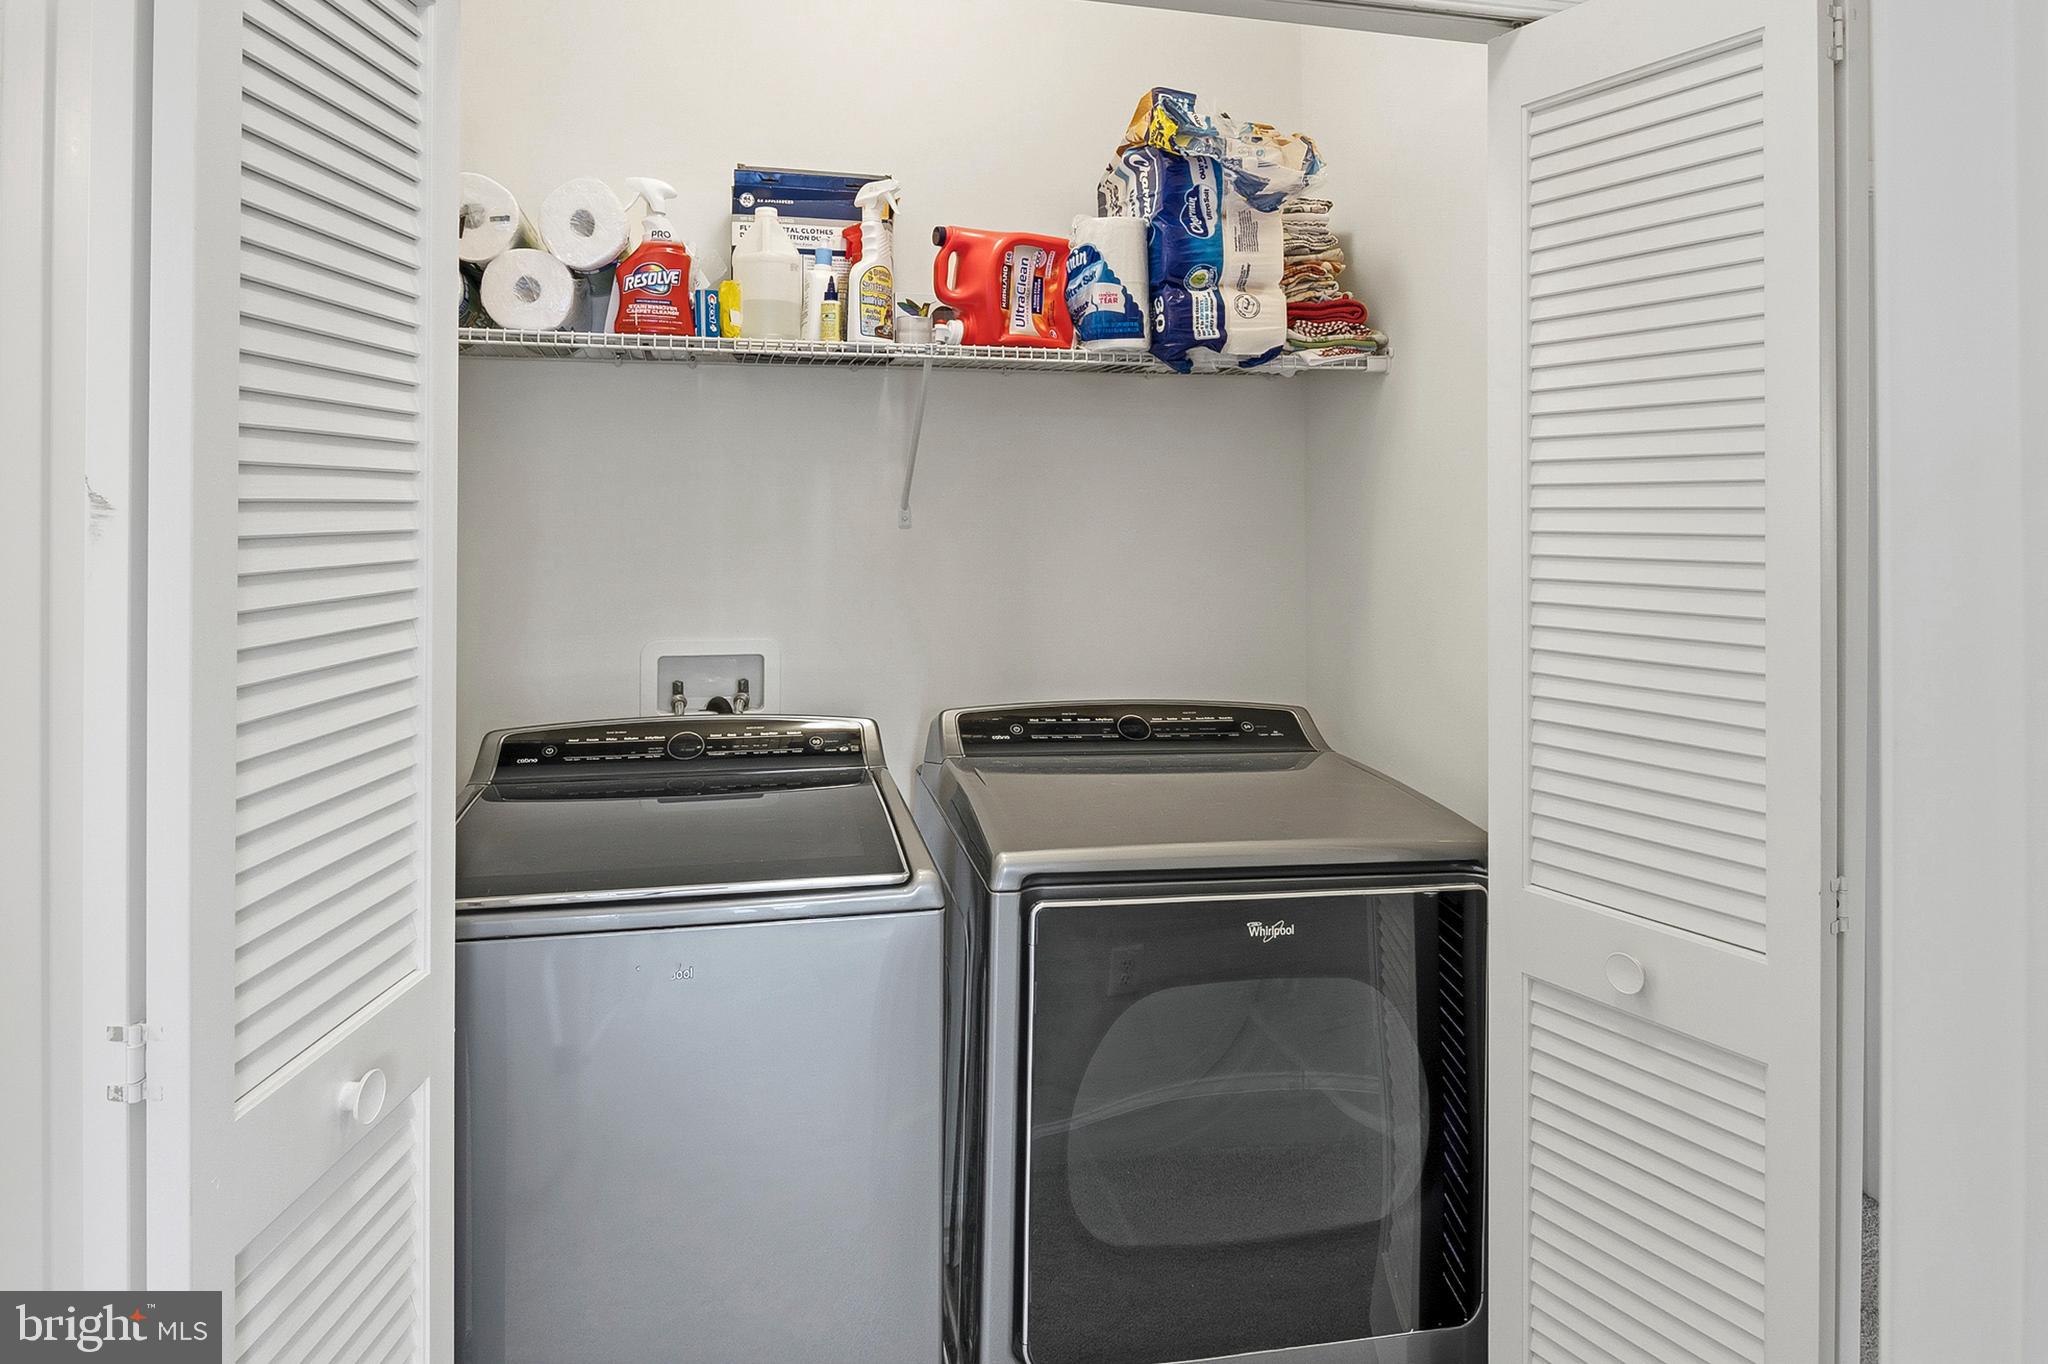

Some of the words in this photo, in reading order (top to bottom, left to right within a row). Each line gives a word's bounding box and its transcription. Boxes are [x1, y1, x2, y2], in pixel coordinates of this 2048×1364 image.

[1188, 197, 1204, 234] Charmin
[651, 230, 672, 239] PRO
[801, 227, 834, 235] CLOTHES
[624, 270, 679, 292] RESOLVE
[1001, 265, 1009, 308] KIRKLAND
[1015, 257, 1029, 328] UltraClean
[1247, 922, 1295, 940] Whirlpool
